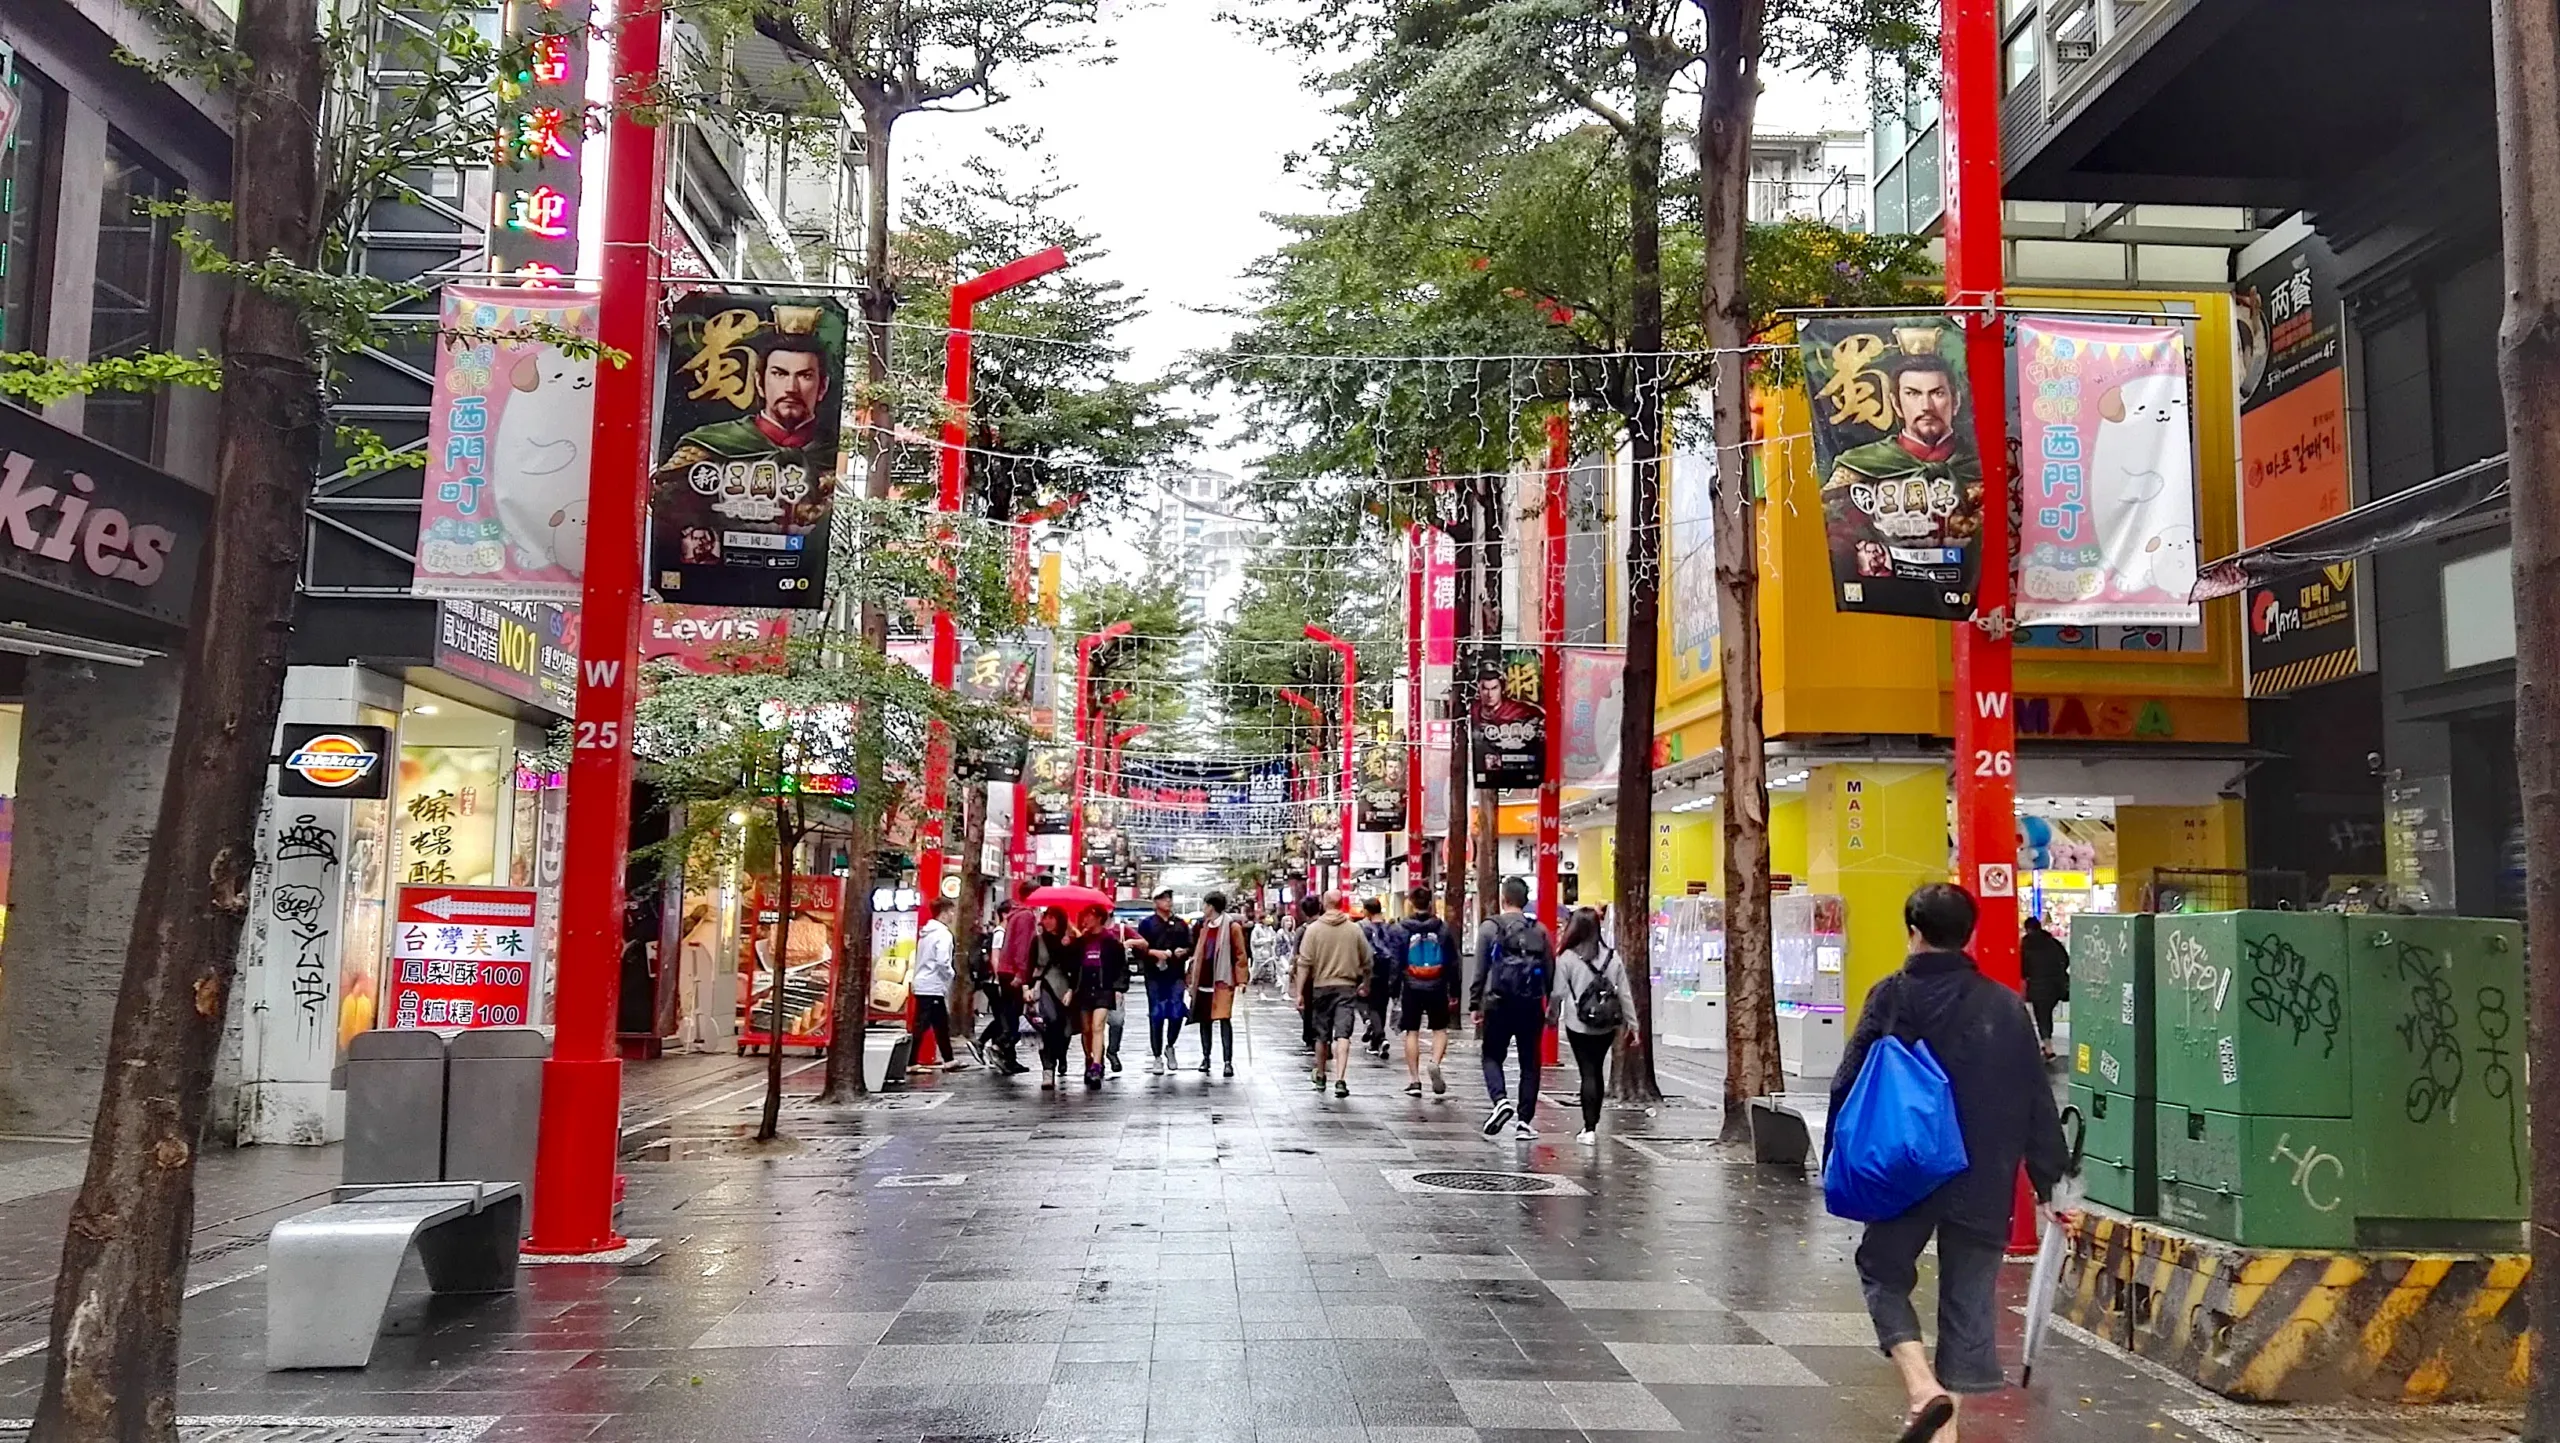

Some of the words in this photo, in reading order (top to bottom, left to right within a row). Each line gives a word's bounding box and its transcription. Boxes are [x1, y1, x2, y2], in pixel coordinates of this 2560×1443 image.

[675, 308, 759, 410] 蜀
[1814, 333, 1895, 431] 蜀
[438, 396, 488, 515] 西門町
[2039, 424, 2085, 541] 西門町
[498, 616, 536, 677] NO.1
[583, 660, 620, 689] W
[1975, 691, 2008, 719] W
[2014, 698, 2175, 737] MASA
[576, 721, 619, 749] 25
[296, 754, 367, 767] Dickies
[1974, 750, 2012, 778] 26
[1543, 816, 1557, 829] W
[1846, 780, 1864, 850] MASA
[1541, 842, 1557, 855] 24
[1659, 824, 1671, 874] MASA
[404, 925, 526, 957] 台灣美味
[400, 960, 479, 986] 鳳梨酥
[481, 965, 523, 986] 100
[396, 989, 420, 1028] 台灣
[477, 1005, 520, 1024] 100
